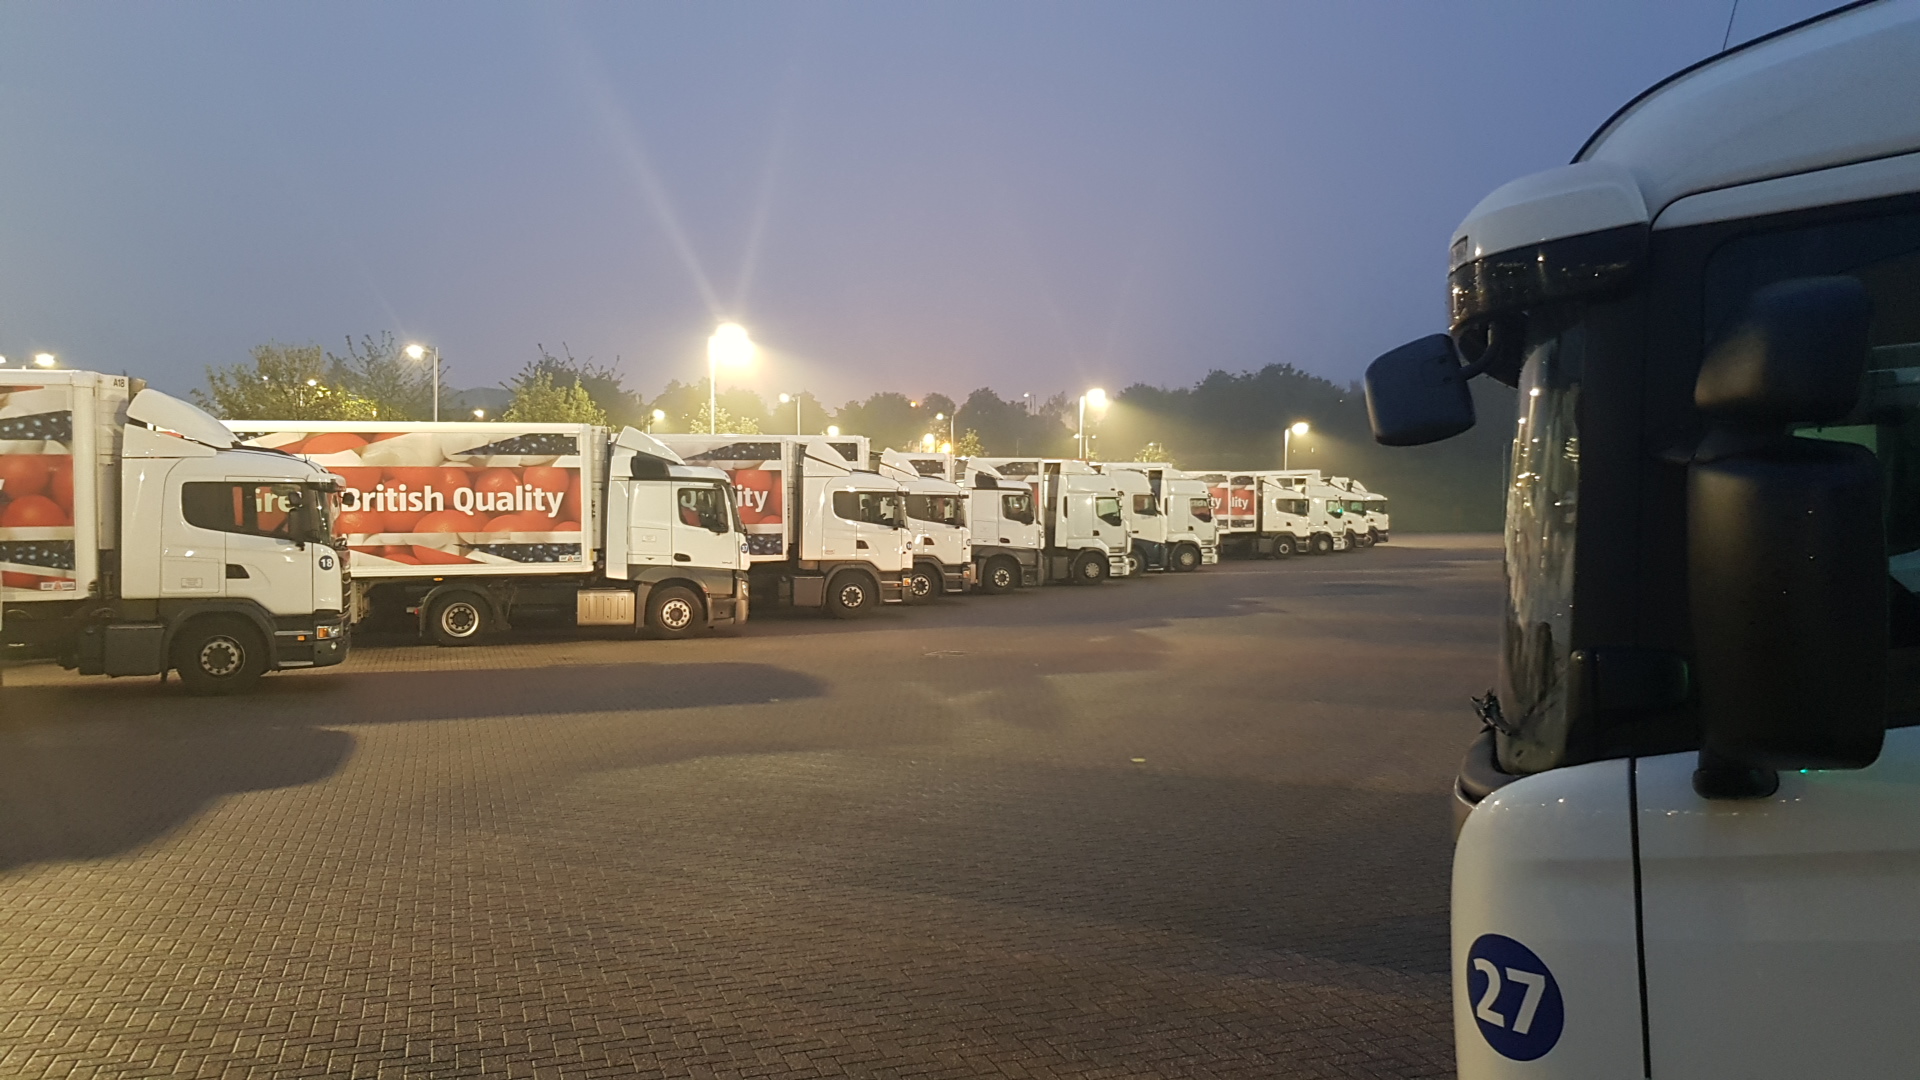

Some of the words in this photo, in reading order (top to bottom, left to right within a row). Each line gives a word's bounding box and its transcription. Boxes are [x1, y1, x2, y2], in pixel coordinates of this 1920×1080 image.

[341, 484, 444, 512] British
[453, 484, 564, 517] Quality
[321, 559, 333, 568] 18
[1473, 957, 1546, 1035] 27
